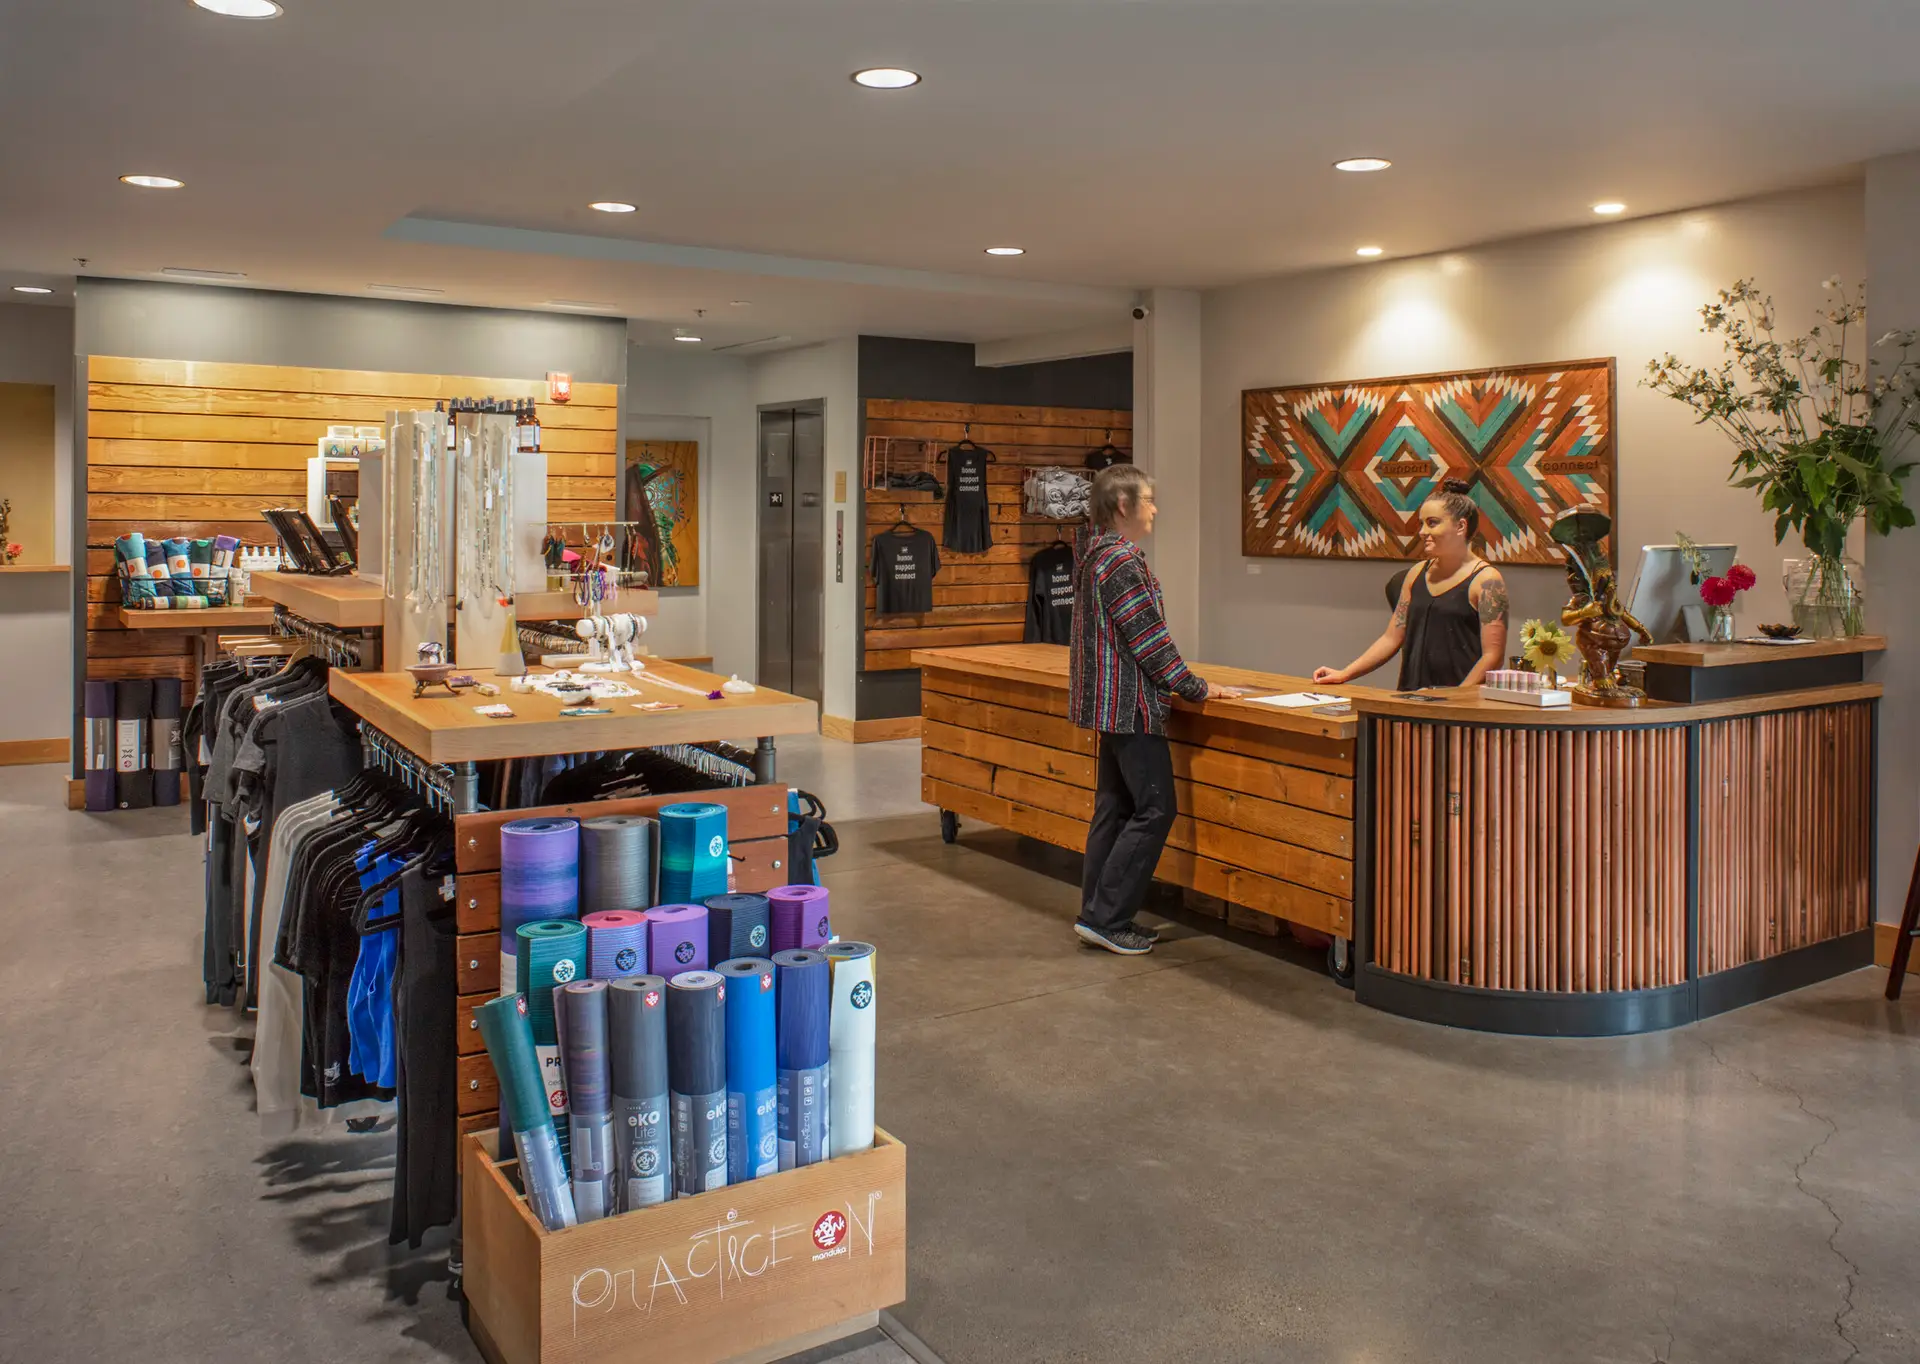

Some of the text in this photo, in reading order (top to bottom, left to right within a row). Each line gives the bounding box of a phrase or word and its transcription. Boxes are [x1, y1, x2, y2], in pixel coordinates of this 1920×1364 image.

[1543, 460, 1599, 471] connect
[960, 476, 979, 484] support
[894, 564, 915, 572] support
[1051, 574, 1070, 583] honor
[1050, 585, 1073, 596] support
[1051, 597, 1075, 606] connect
[634, 1127, 656, 1139] Lite
[812, 1246, 848, 1262] manduka
